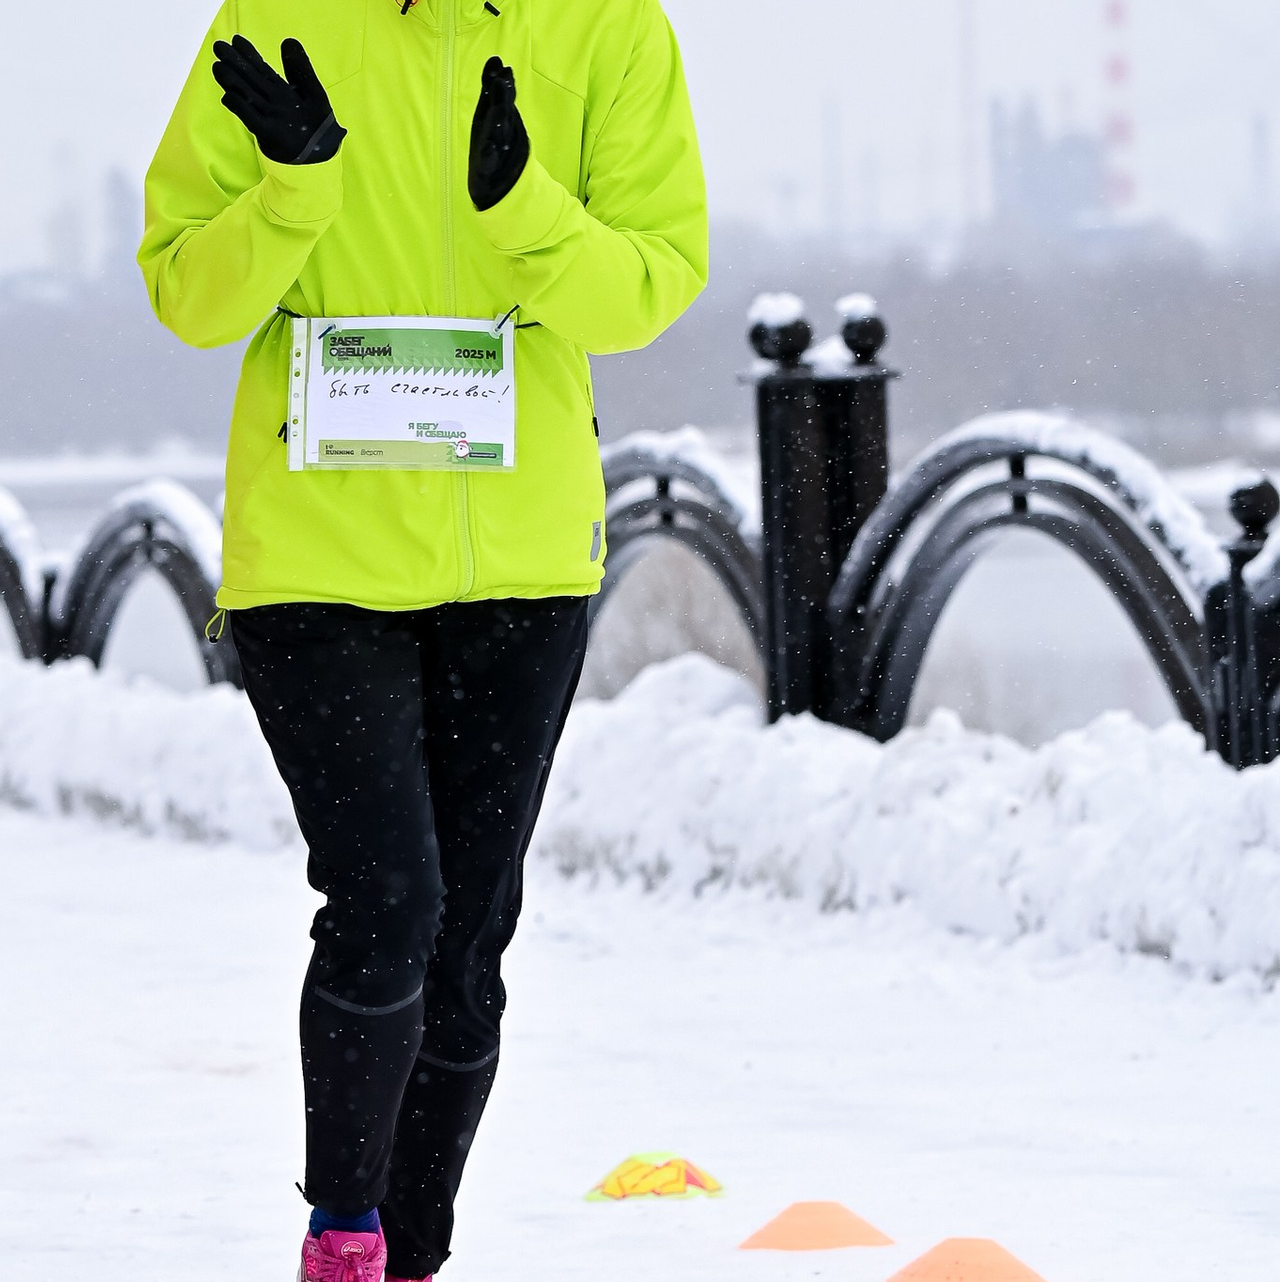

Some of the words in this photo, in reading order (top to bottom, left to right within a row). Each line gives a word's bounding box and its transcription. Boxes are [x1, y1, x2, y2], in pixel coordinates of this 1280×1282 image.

[329, 336, 366, 347] ЗАБЕГ
[329, 343, 392, 360] ОБЕЩАНИЙ
[454, 348, 485, 360] 2025
[408, 422, 415, 430] Я
[416, 422, 439, 430] БЕГУ
[416, 430, 423, 438] И
[424, 430, 467, 439] ОБЕЩАЮ
